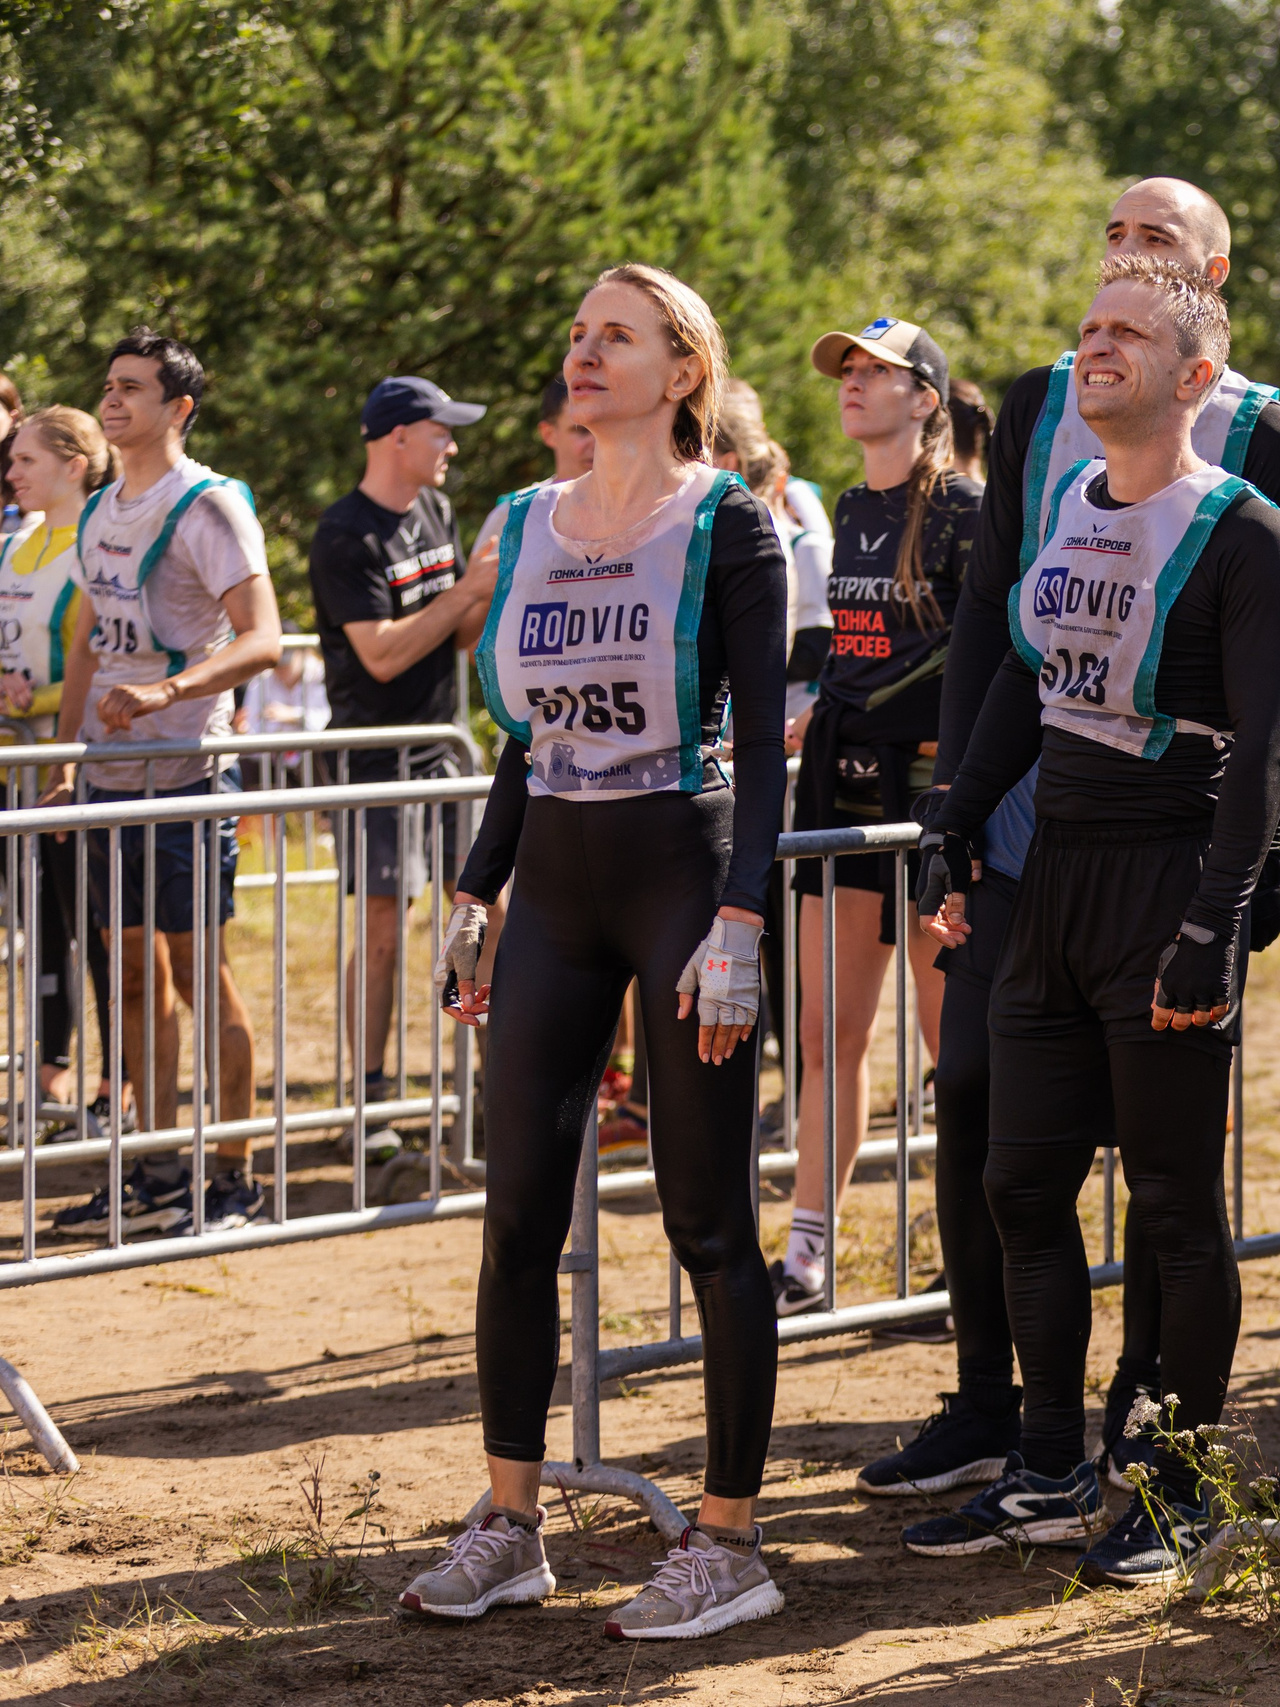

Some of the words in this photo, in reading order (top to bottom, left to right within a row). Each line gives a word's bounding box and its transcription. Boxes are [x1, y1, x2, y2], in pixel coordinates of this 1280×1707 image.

[1063, 536, 1088, 547] ГОНКА
[1090, 537, 1132, 552] ГЕРОЕВ
[549, 565, 584, 581] ГОНКА
[587, 562, 633, 578] ГЕРОЕВ
[521, 603, 649, 650] RODVIG
[525, 682, 647, 735] 5165
